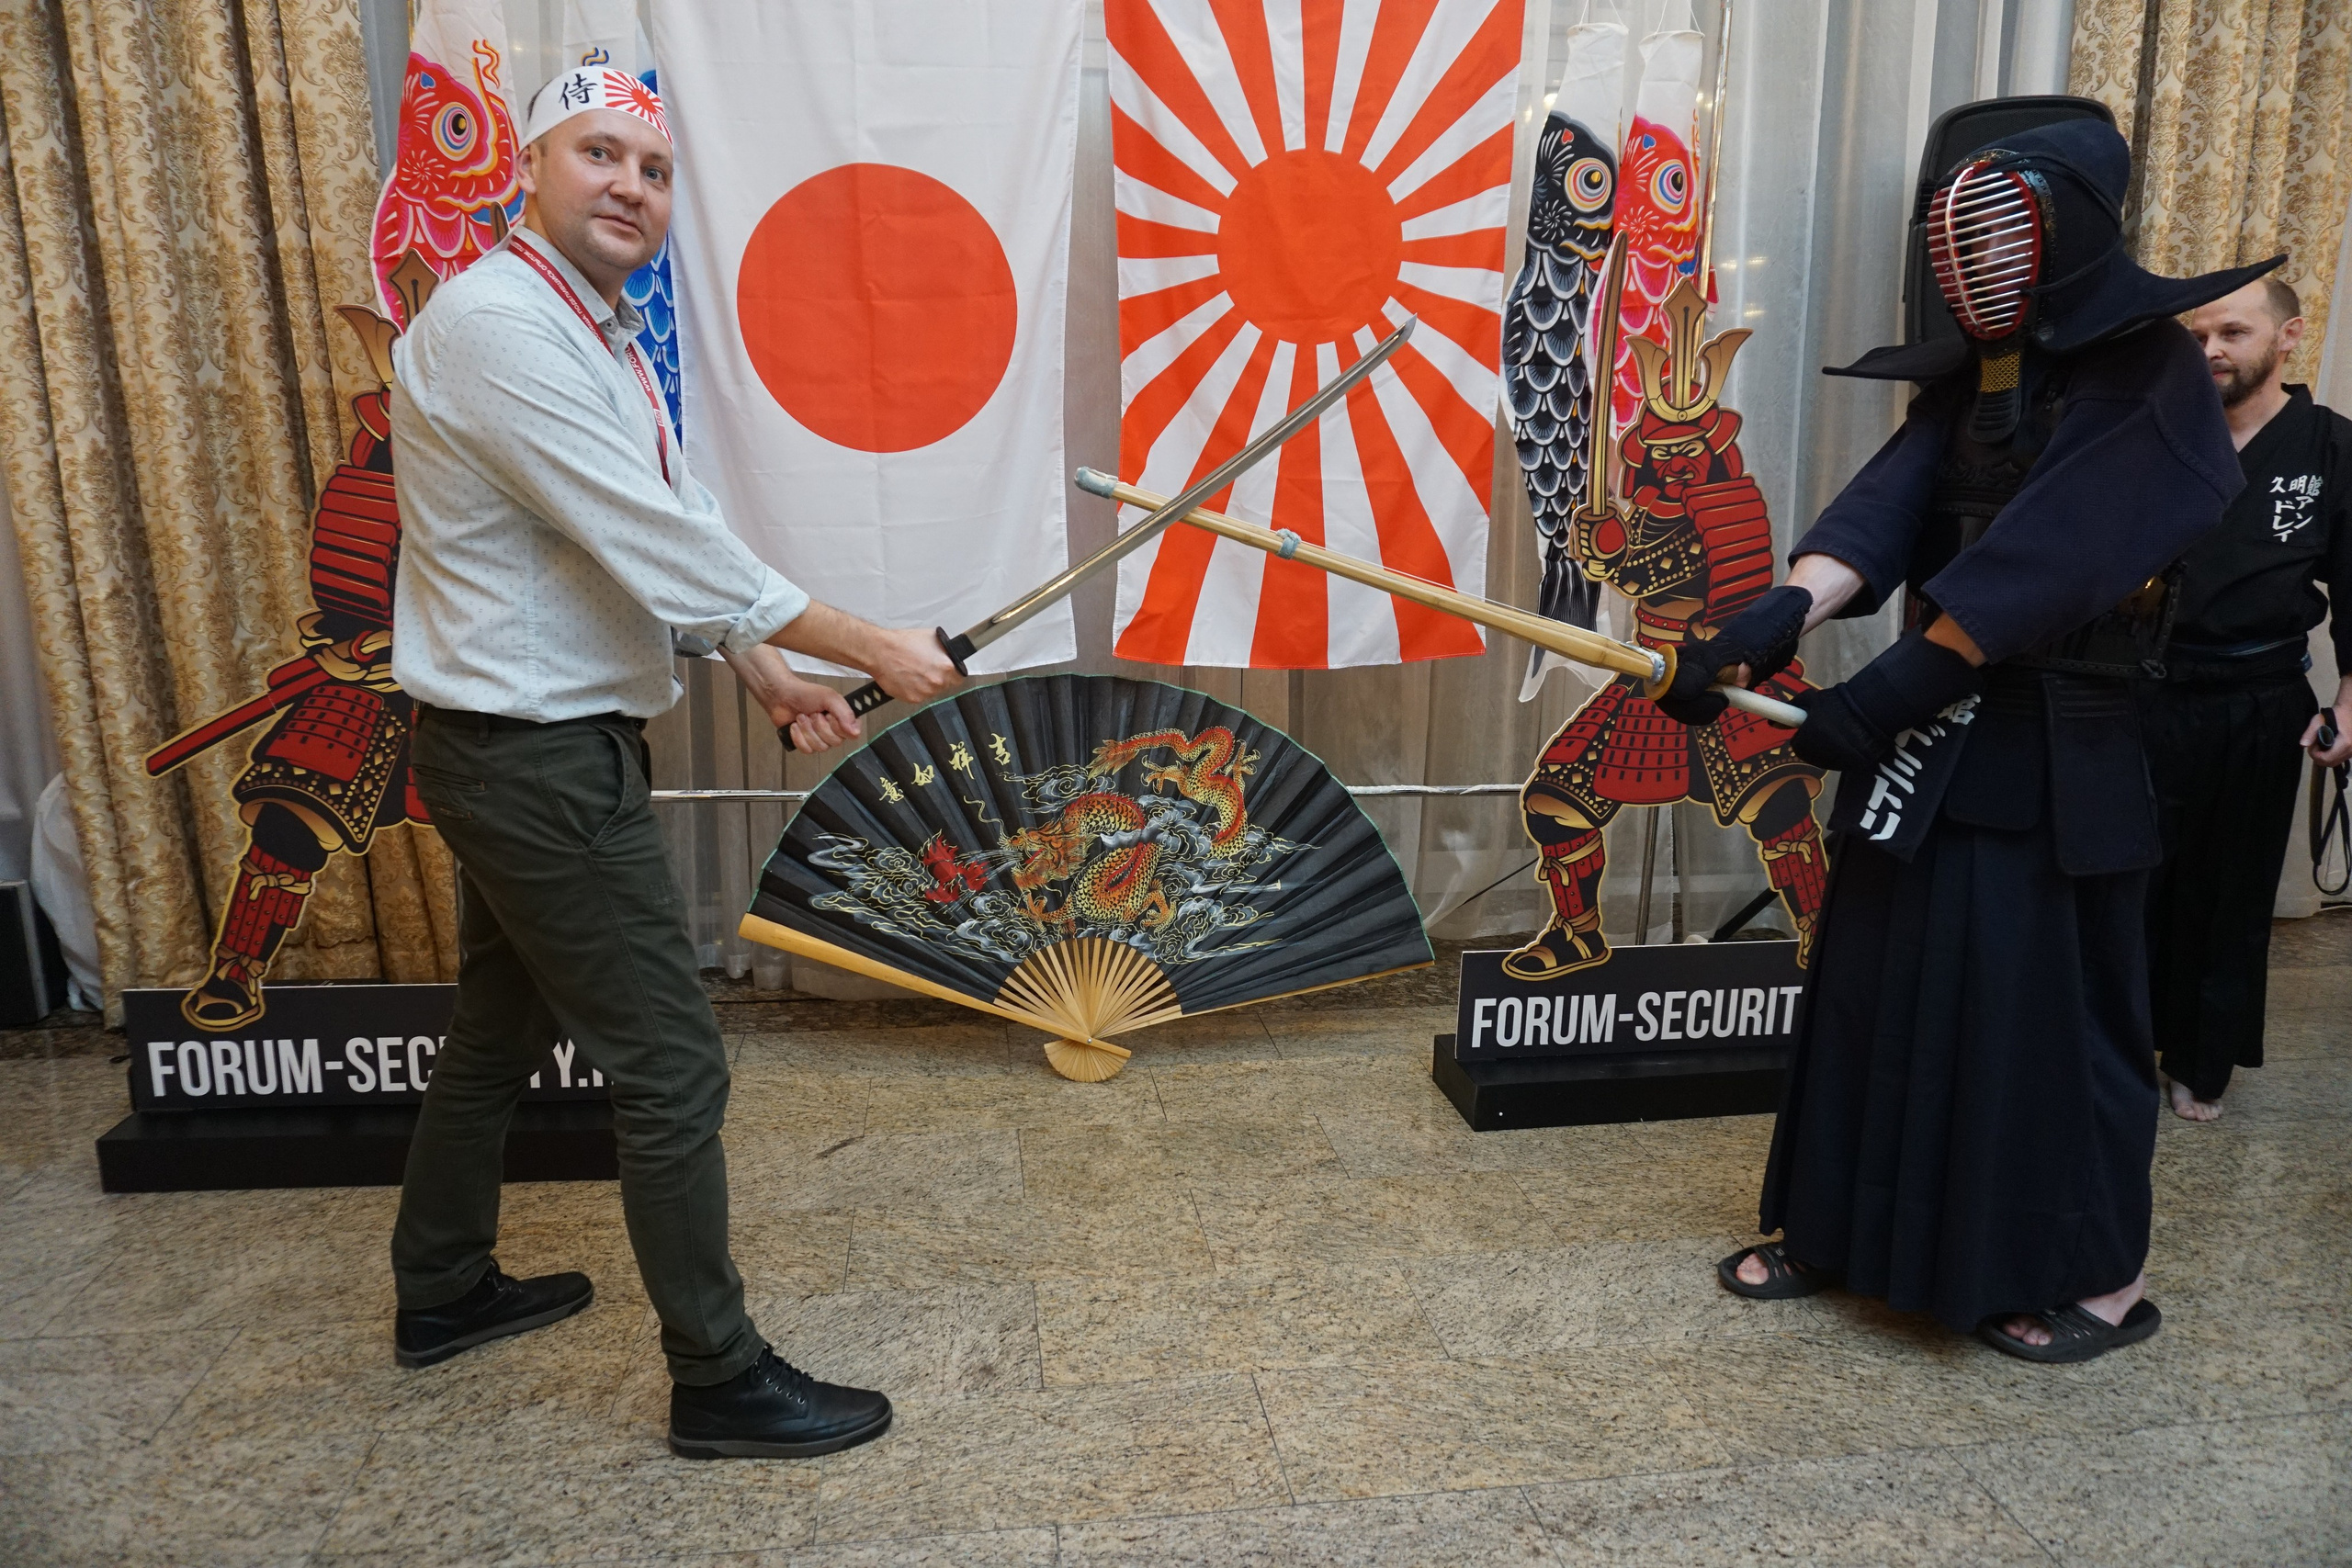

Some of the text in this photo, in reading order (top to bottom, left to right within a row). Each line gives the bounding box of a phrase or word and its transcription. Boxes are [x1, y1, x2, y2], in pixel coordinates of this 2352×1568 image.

[559, 73, 598, 111] 侍
[545, 267, 582, 314] ПОДЕЛИВШИСЬ
[1471, 985, 1804, 1049] FORUM-SECURIT
